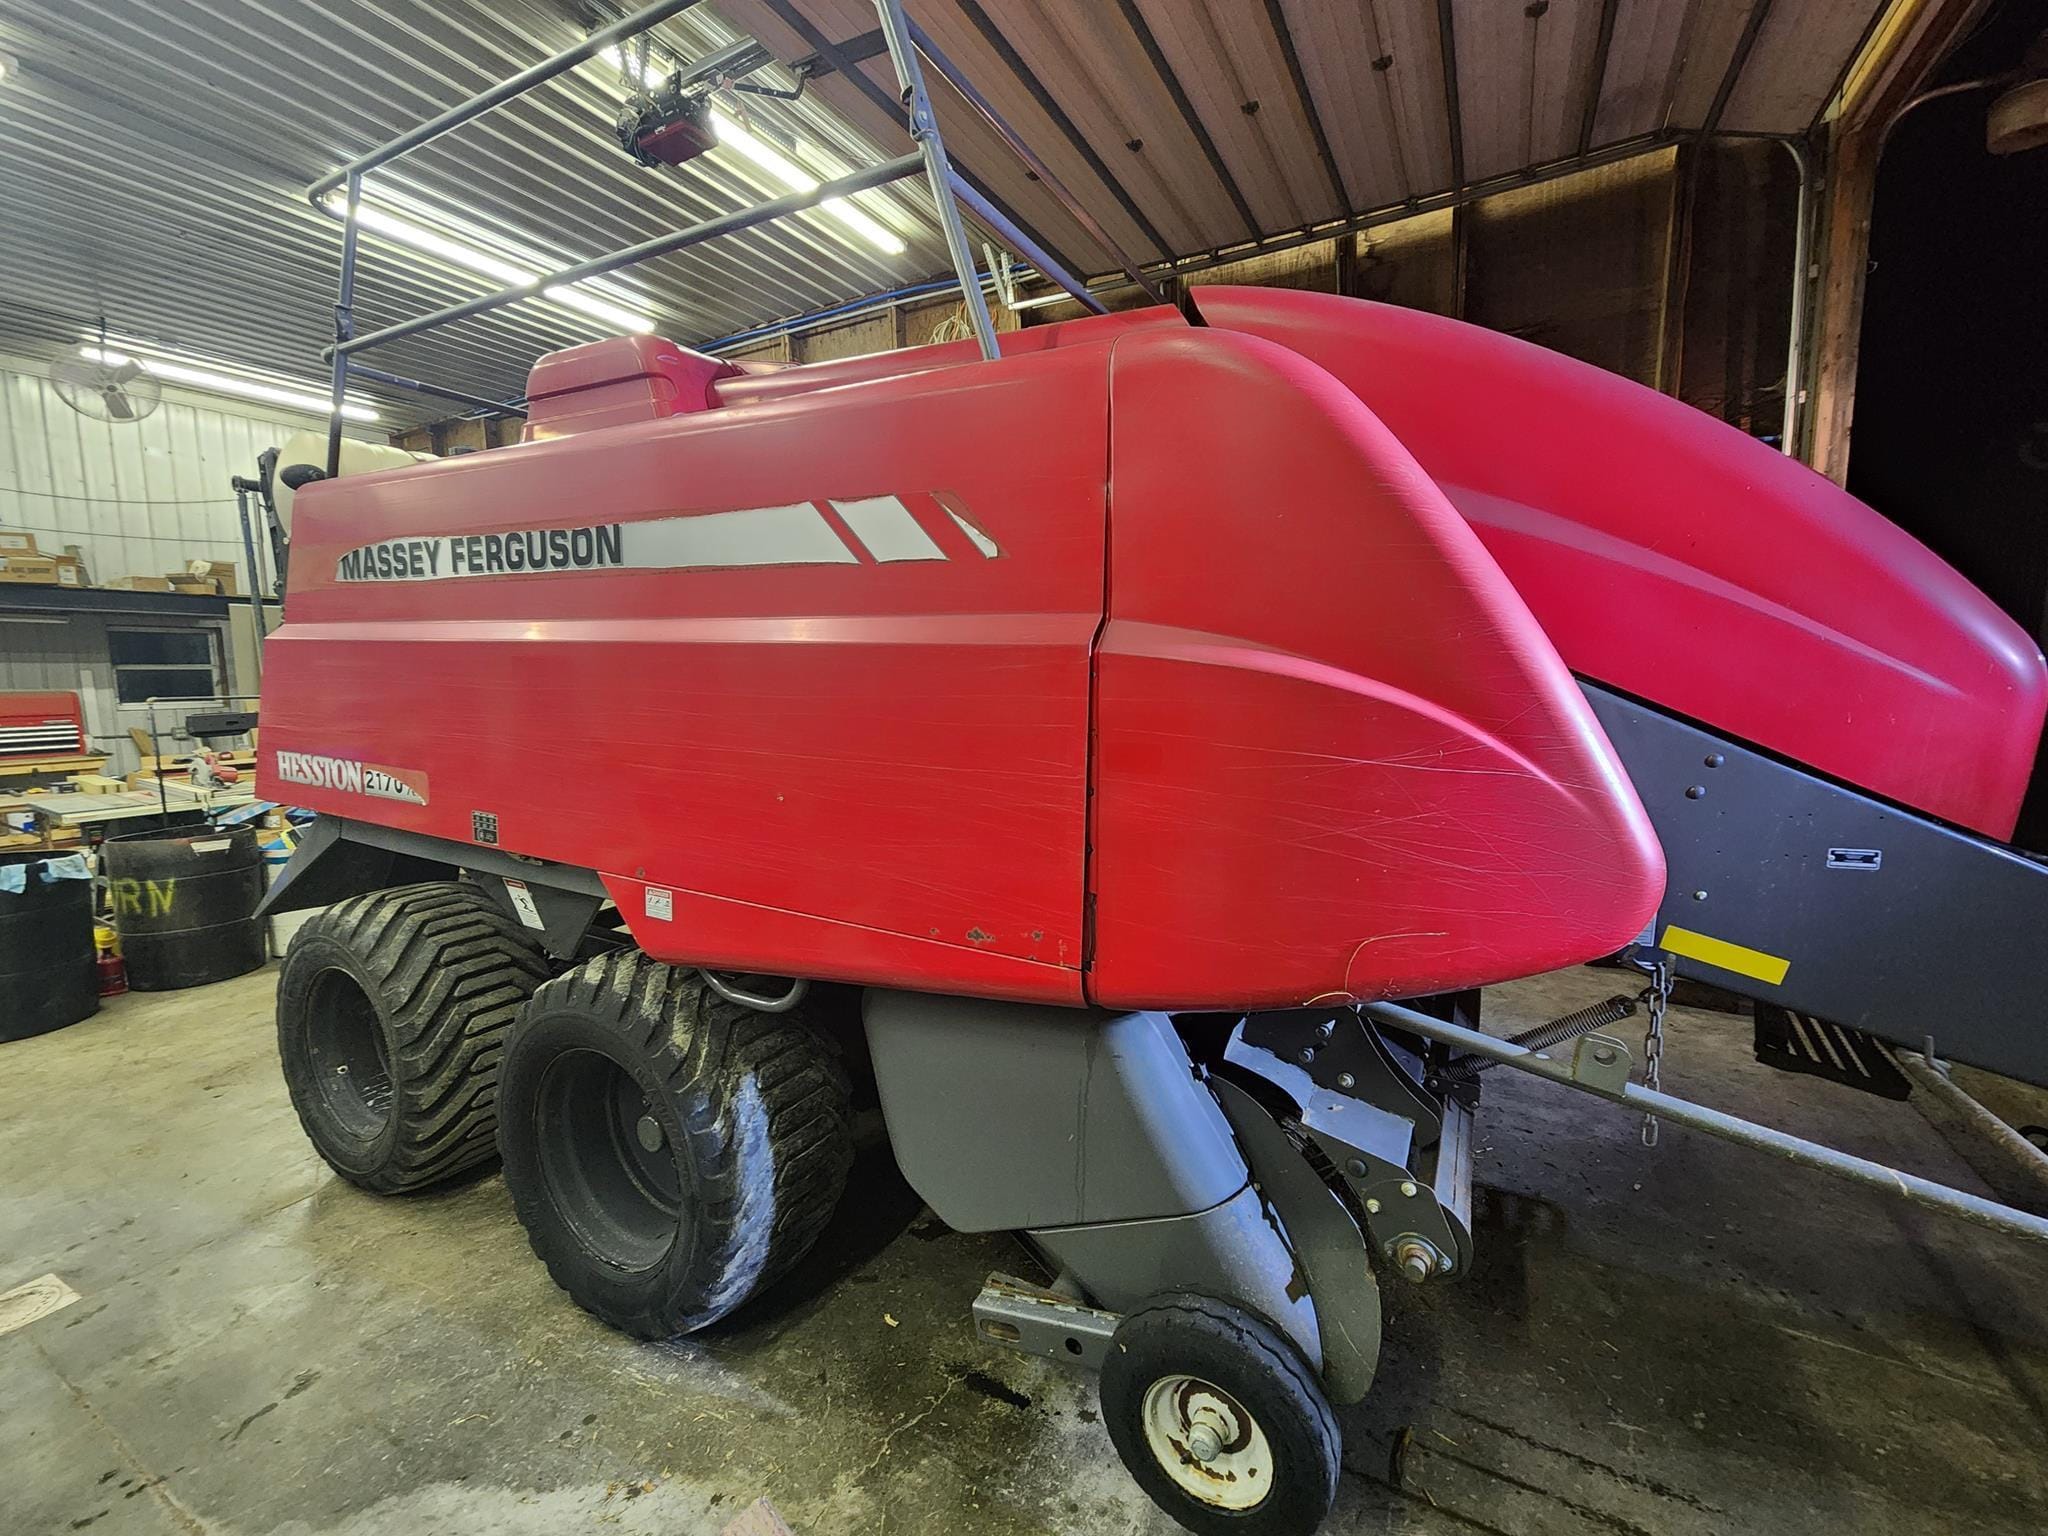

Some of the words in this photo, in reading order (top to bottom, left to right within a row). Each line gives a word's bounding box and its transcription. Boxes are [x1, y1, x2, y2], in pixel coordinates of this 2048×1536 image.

[341, 539, 441, 580] MASSEY
[451, 523, 623, 575] FERGUSON
[276, 750, 363, 794] HESSTON
[364, 770, 417, 796] 2170
